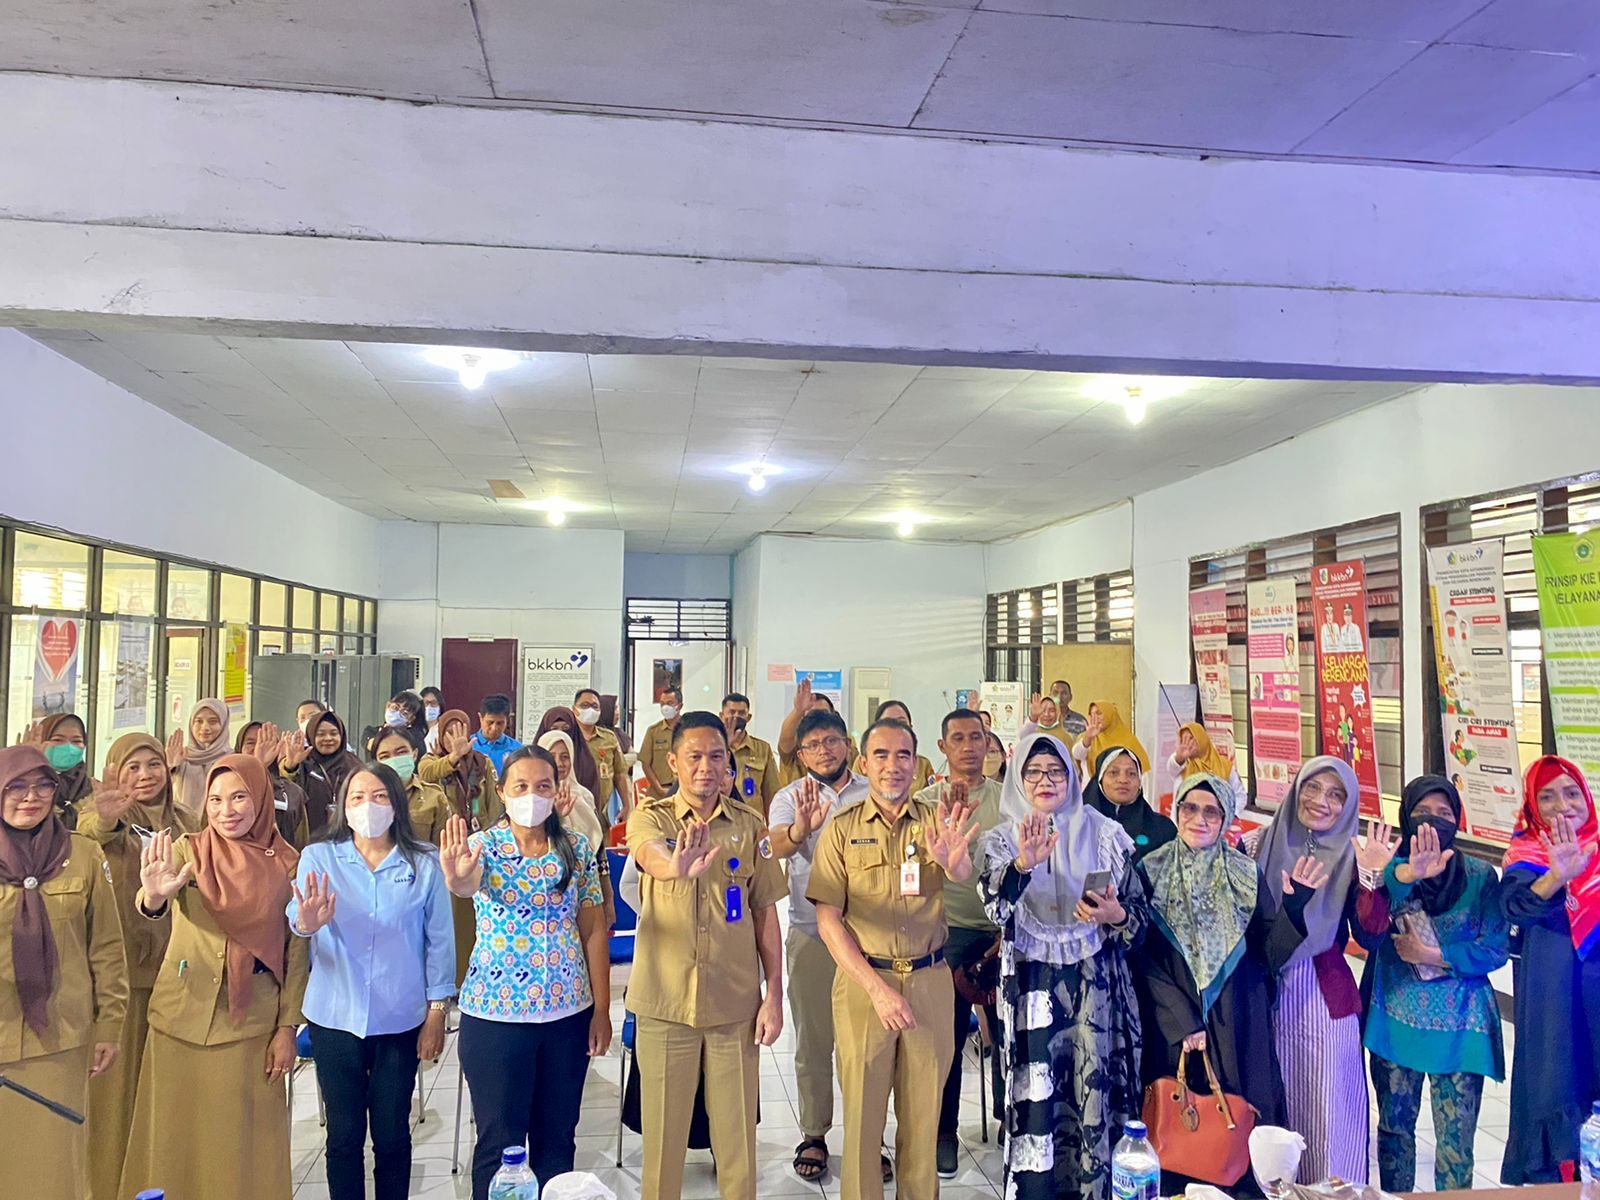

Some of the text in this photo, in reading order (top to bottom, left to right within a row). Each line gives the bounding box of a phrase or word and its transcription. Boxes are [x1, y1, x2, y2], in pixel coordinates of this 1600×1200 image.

[1545, 572, 1596, 588] PRINSIP KIE
[528, 658, 573, 671] bkkbn
[1324, 655, 1368, 671] KELUARGA
[1322, 668, 1369, 683] BERENCANA
[1484, 718, 1514, 727] STUNTING
